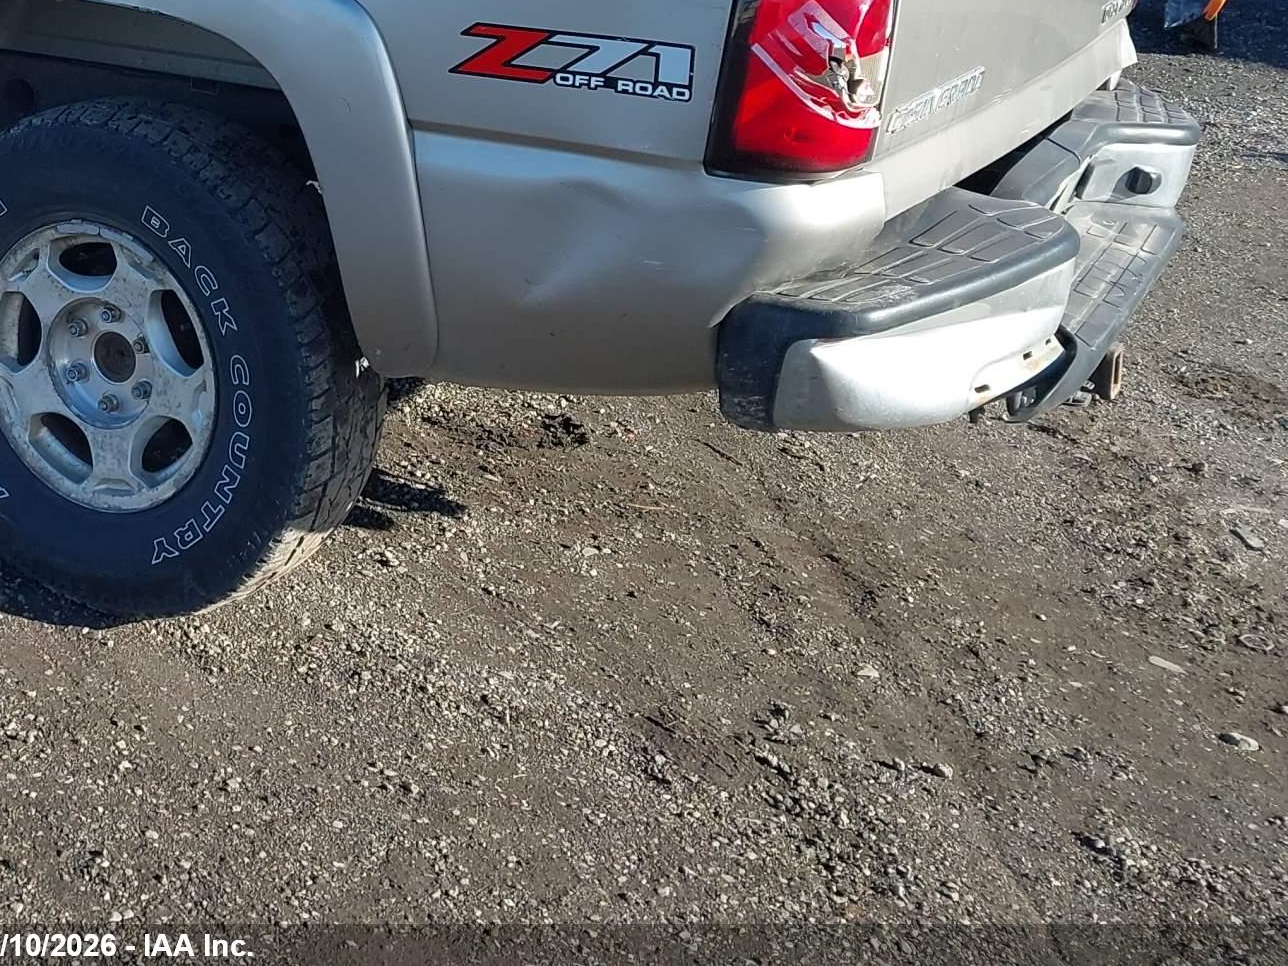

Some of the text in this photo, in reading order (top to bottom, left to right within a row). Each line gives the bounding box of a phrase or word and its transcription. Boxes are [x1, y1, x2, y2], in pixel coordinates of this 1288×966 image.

[448, 21, 696, 85] Z71
[554, 73, 691, 101] OFF ROAD
[142, 205, 253, 565] BACK COUNTRY
